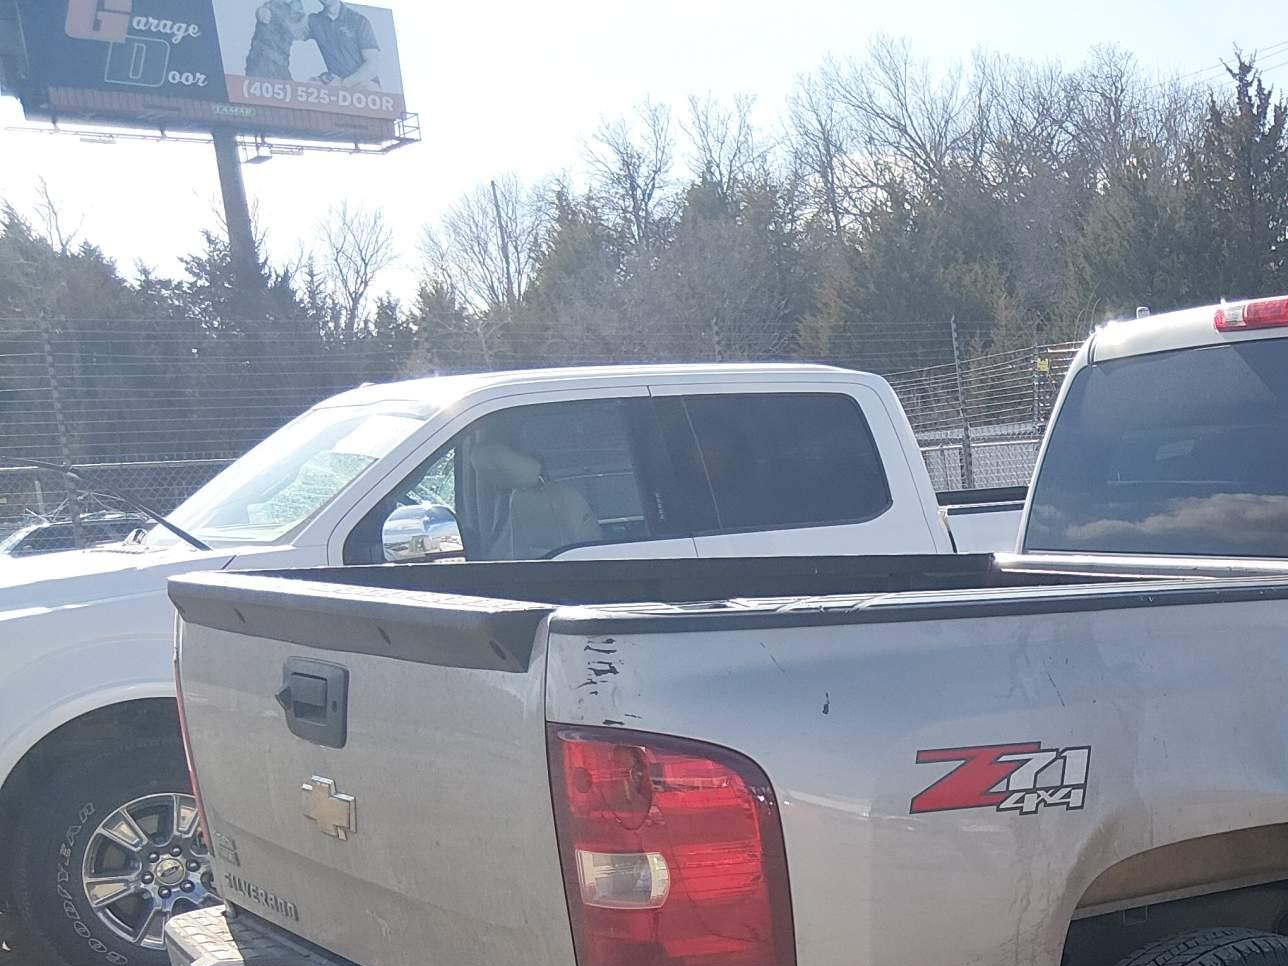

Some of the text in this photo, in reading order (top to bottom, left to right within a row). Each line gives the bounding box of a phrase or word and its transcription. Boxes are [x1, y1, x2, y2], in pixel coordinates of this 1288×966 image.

[104, 35, 209, 87] Door
[243, 80, 395, 112] (405) 525-DOOR
[910, 741, 1091, 814] Z71
[57, 801, 129, 966] GOODYEAR
[225, 871, 300, 922] SILVERADO
